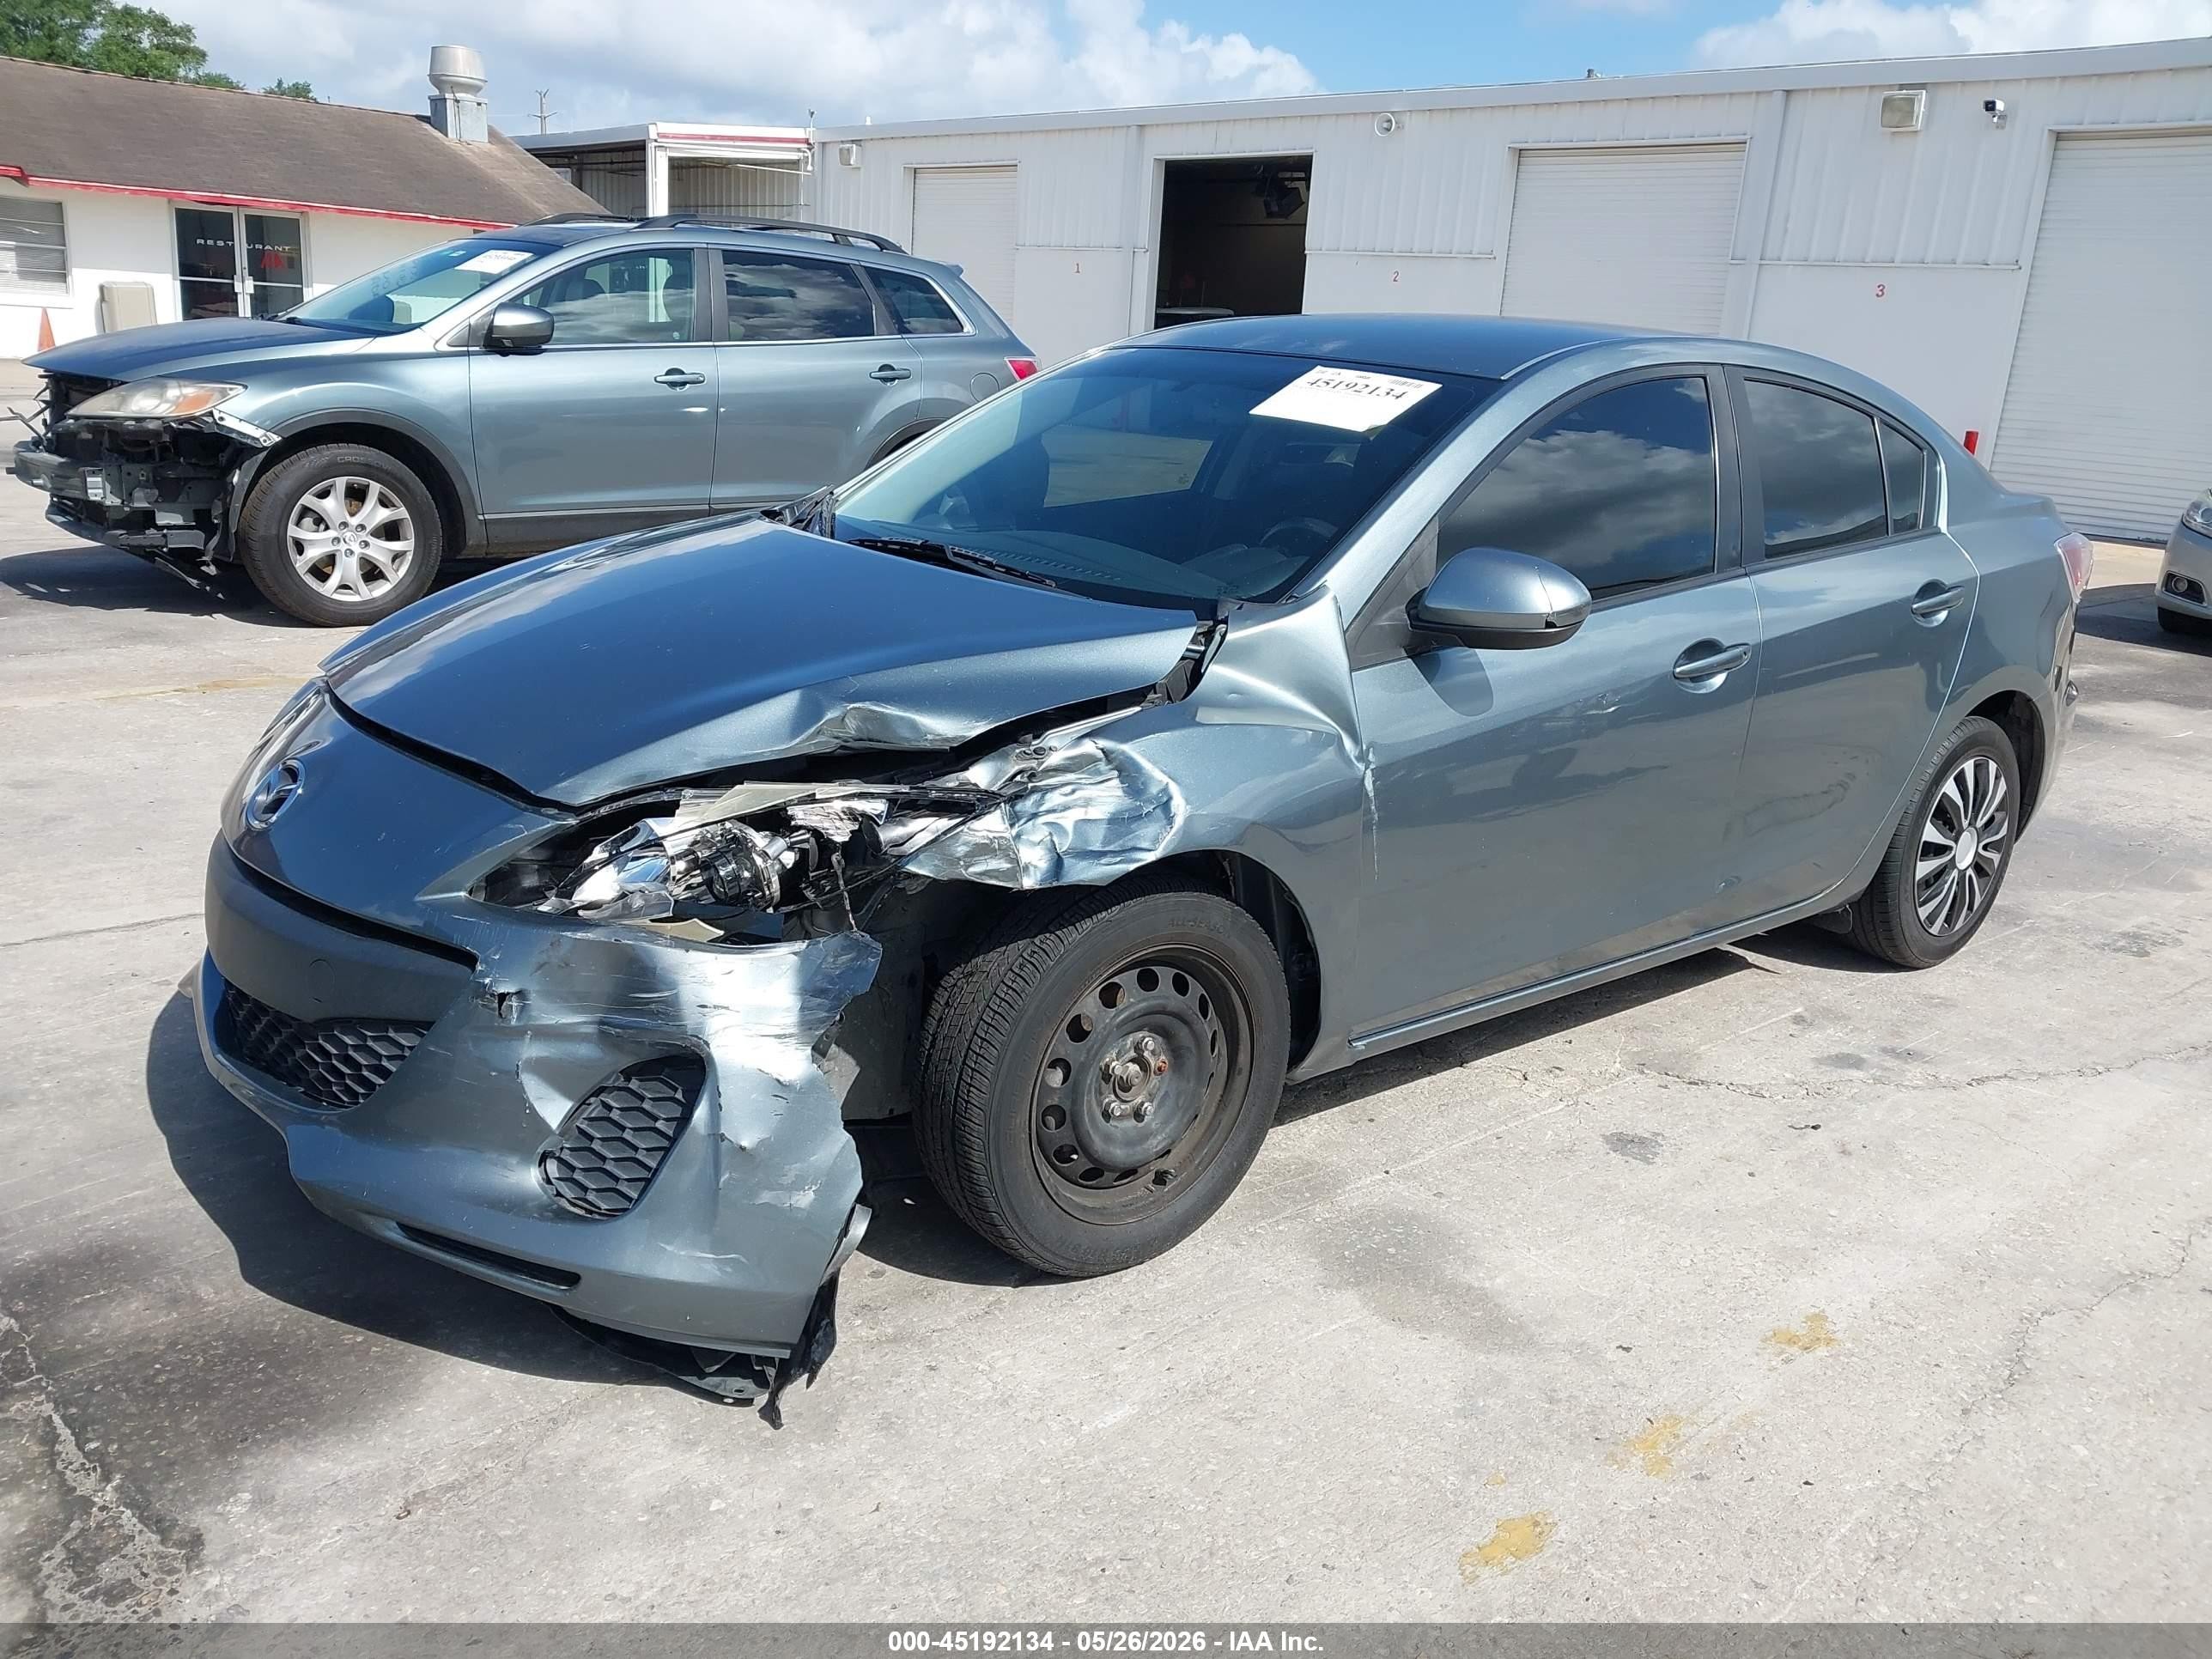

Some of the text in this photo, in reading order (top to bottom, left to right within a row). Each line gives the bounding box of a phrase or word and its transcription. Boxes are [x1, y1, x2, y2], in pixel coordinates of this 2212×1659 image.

[197, 239, 291, 251] RESTURANT
[1074, 263, 1081, 274] 1
[1393, 270, 1400, 283] 2
[1875, 283, 1886, 298] 3
[1307, 378, 1408, 399] 45192134
